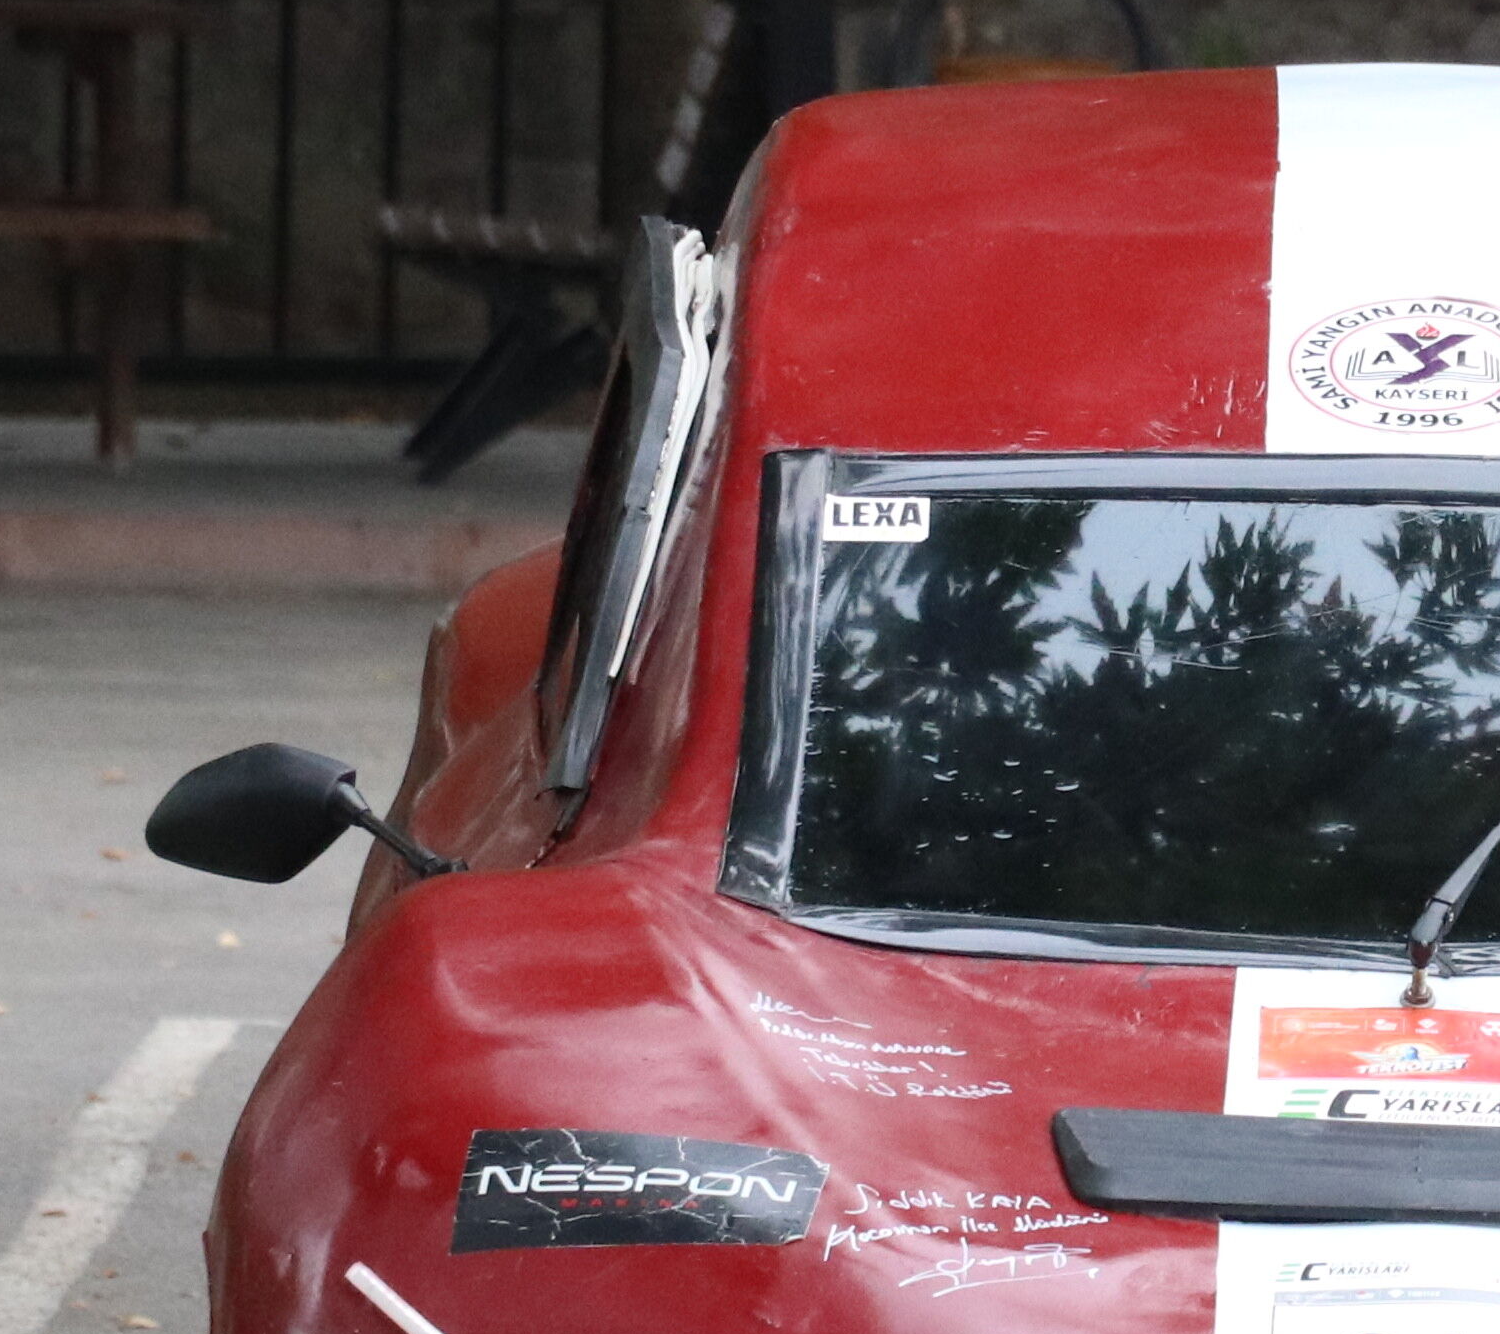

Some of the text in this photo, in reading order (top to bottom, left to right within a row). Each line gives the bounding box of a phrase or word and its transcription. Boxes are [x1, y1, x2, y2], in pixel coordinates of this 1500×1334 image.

[1301, 304, 1396, 359] YANGIN
[1296, 366, 1359, 412] SAMİ
[1374, 387, 1470, 402] KAYSERİ
[1373, 411, 1464, 428] 1996
[832, 502, 922, 527] LEXA
[476, 1164, 798, 1203] NESPON
